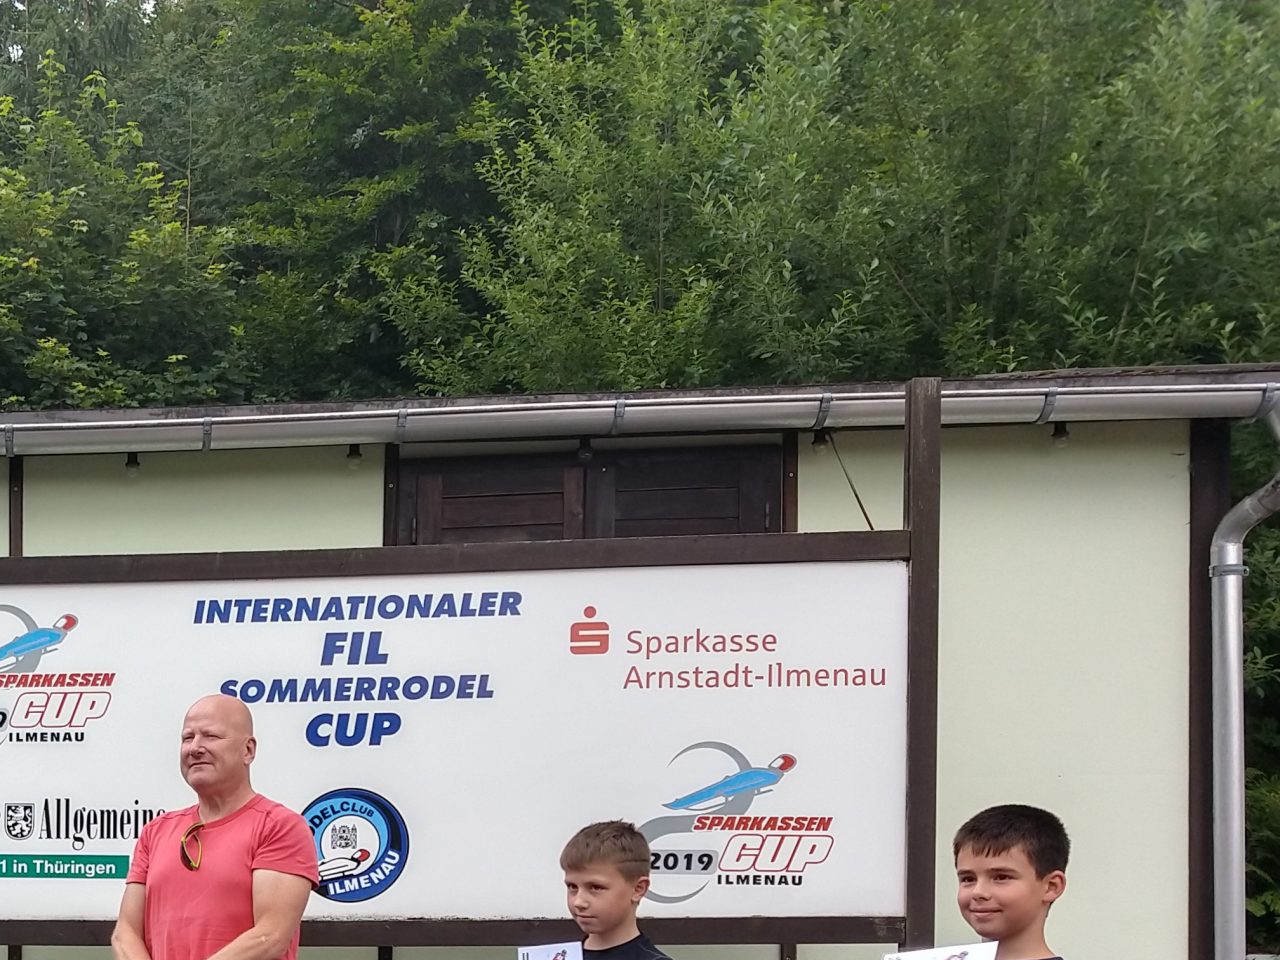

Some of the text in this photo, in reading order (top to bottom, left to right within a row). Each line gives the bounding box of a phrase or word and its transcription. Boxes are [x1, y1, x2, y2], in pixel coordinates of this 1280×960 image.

[193, 591, 523, 624] INTERNATIONALER
[320, 631, 389, 666] FIL
[626, 629, 778, 660] Sparkasse
[220, 674, 494, 704] SOMMERRODEL
[623, 662, 888, 690] Arnstadt-Ilmenau
[9, 691, 112, 729] CUP
[8, 731, 86, 743] ILMENAU
[305, 712, 402, 747] CUP
[39, 798, 166, 851] Allgemein
[693, 815, 833, 832] SPARKASSEN
[0, 859, 8, 874] 1
[12, 859, 28, 874] in
[32, 858, 117, 879] Thüringen
[650, 852, 714, 872] 2019
[718, 833, 835, 873] CUP
[328, 850, 401, 896] ILMENAU
[717, 874, 804, 887] ILMENAU
